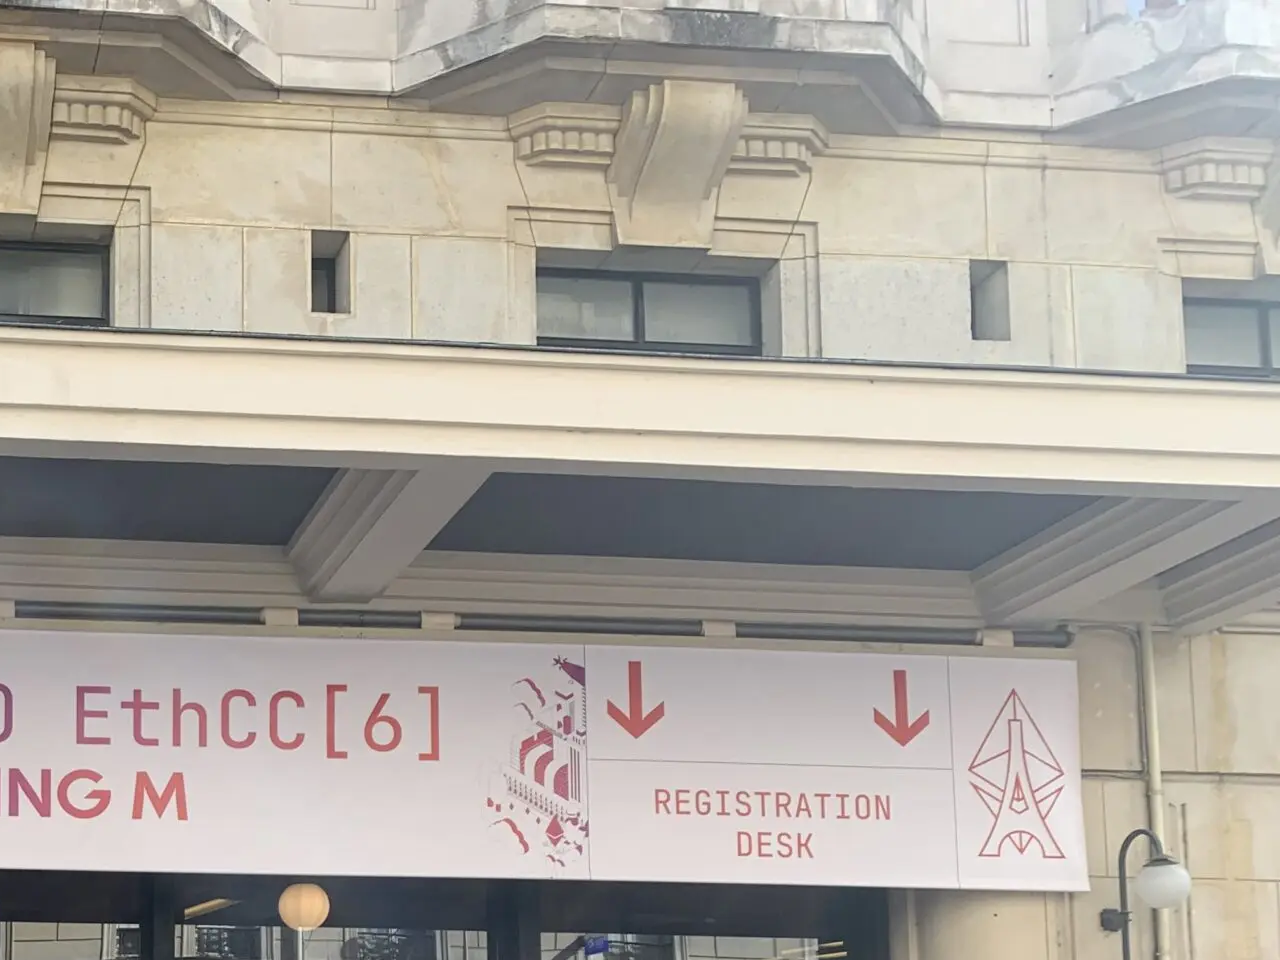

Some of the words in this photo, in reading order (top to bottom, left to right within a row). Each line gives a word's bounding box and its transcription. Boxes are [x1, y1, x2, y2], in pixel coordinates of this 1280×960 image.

[75, 684, 440, 761] EthCC[6]
[131, 771, 189, 821] M
[654, 788, 891, 821] REGISTRATION
[736, 830, 814, 859] DESK
